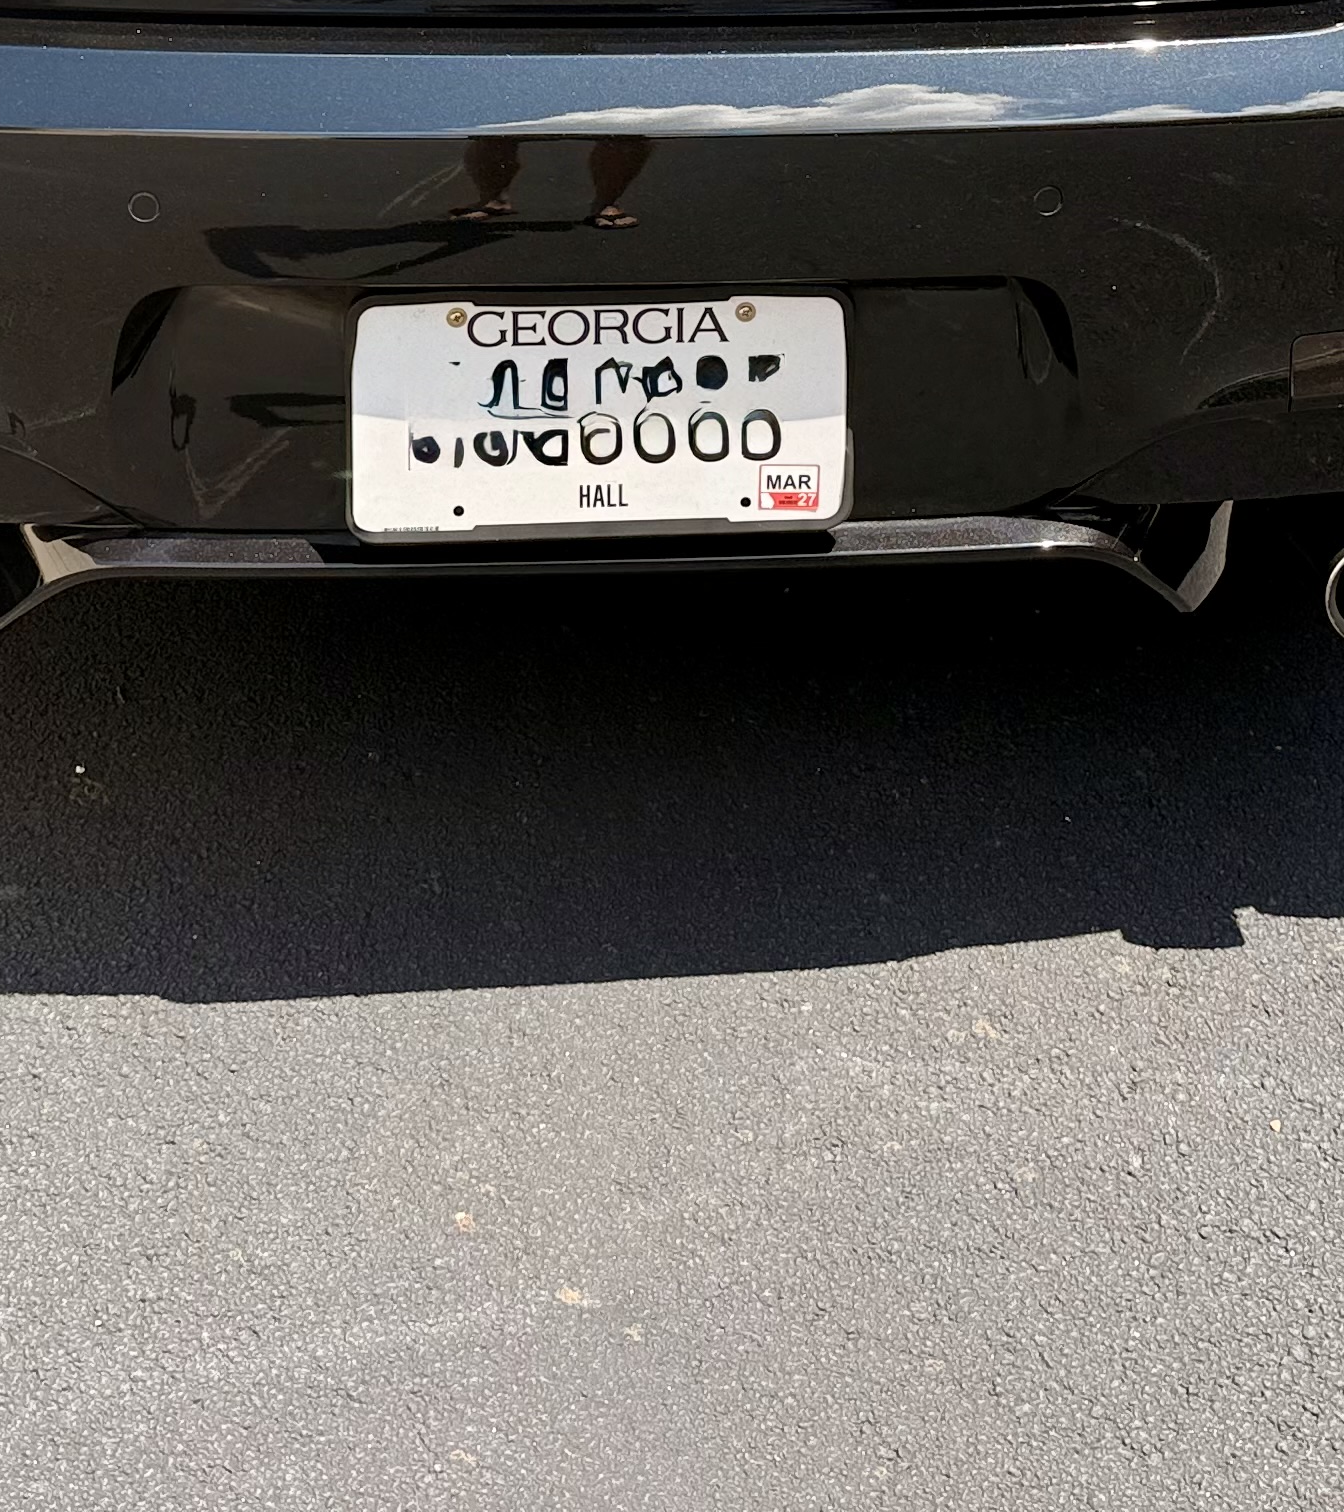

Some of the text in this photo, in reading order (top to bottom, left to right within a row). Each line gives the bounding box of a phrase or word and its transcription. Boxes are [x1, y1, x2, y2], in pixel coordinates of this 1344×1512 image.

[467, 307, 729, 348] GEORGIA
[766, 474, 812, 490] MAR
[579, 484, 629, 509] HALL
[797, 493, 817, 507] 27
